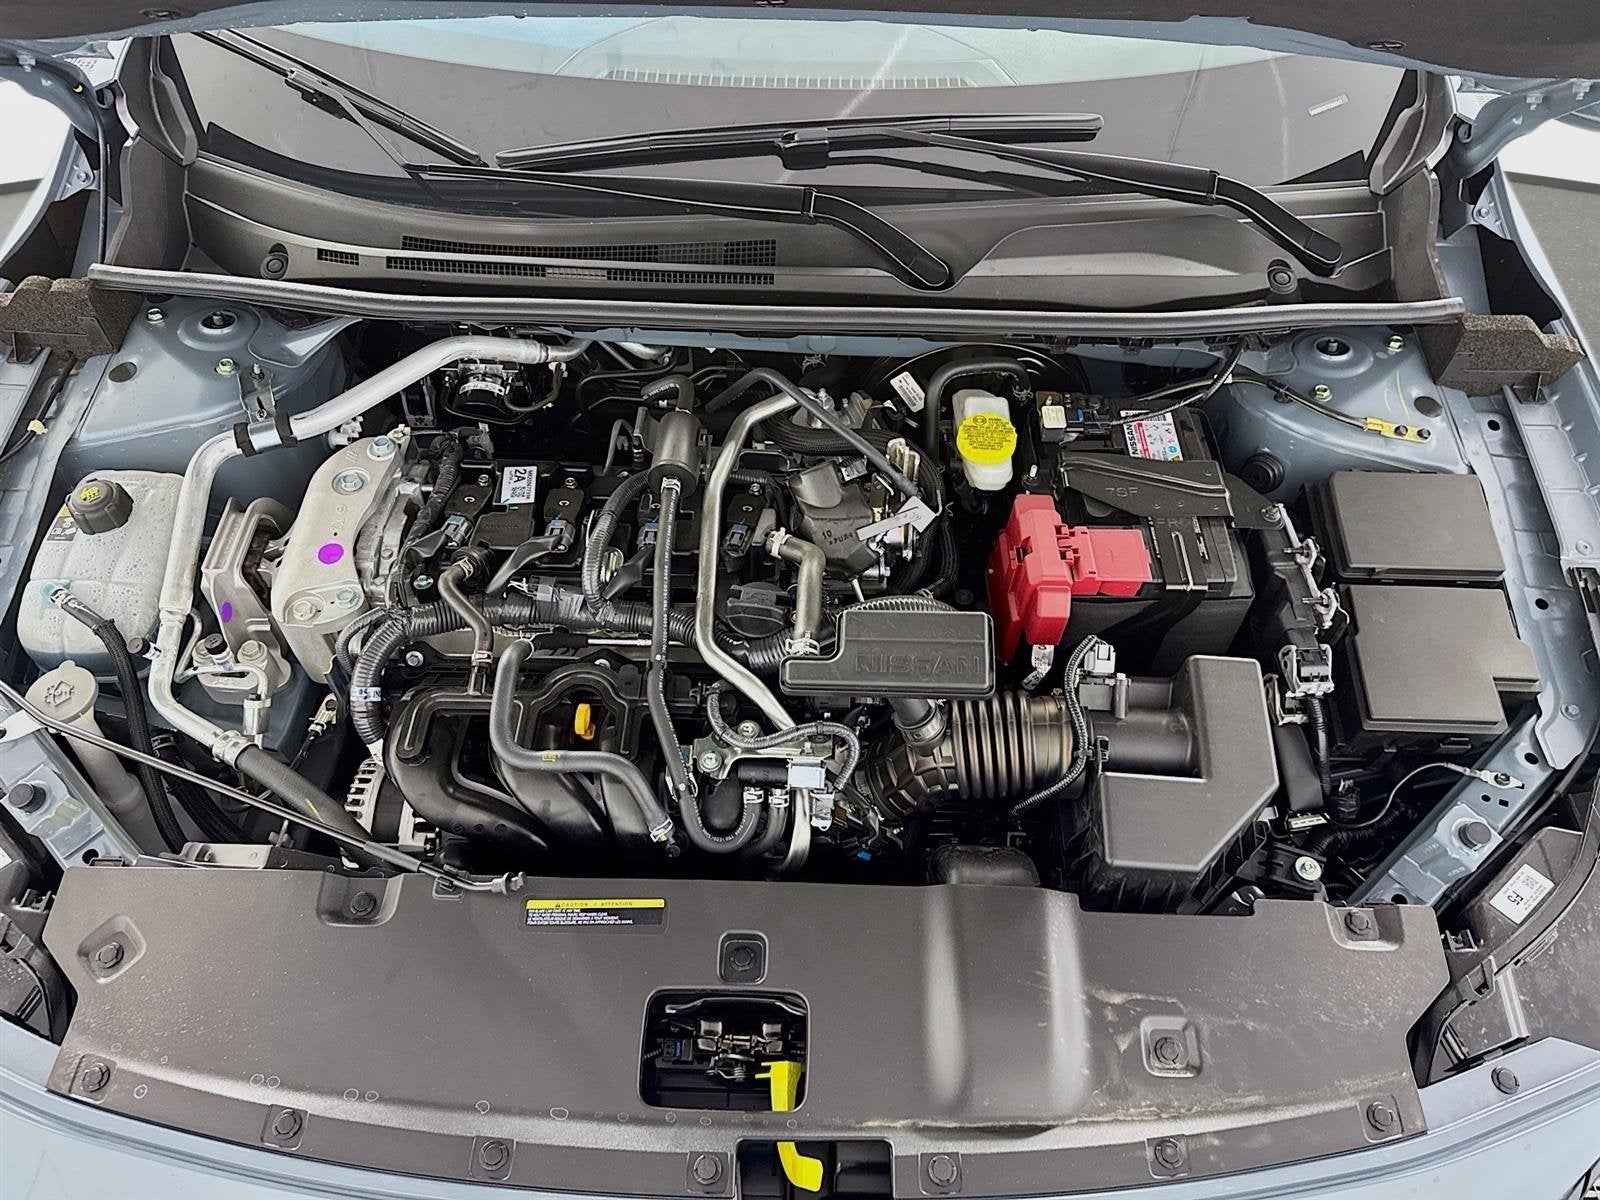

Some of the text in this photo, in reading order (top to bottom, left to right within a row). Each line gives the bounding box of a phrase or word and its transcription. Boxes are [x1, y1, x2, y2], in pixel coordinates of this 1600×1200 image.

[1126, 423, 1139, 456] NISSAN
[513, 468, 527, 483] 2A
[855, 654, 980, 674] NISSAN
[1507, 890, 1524, 906] F5
